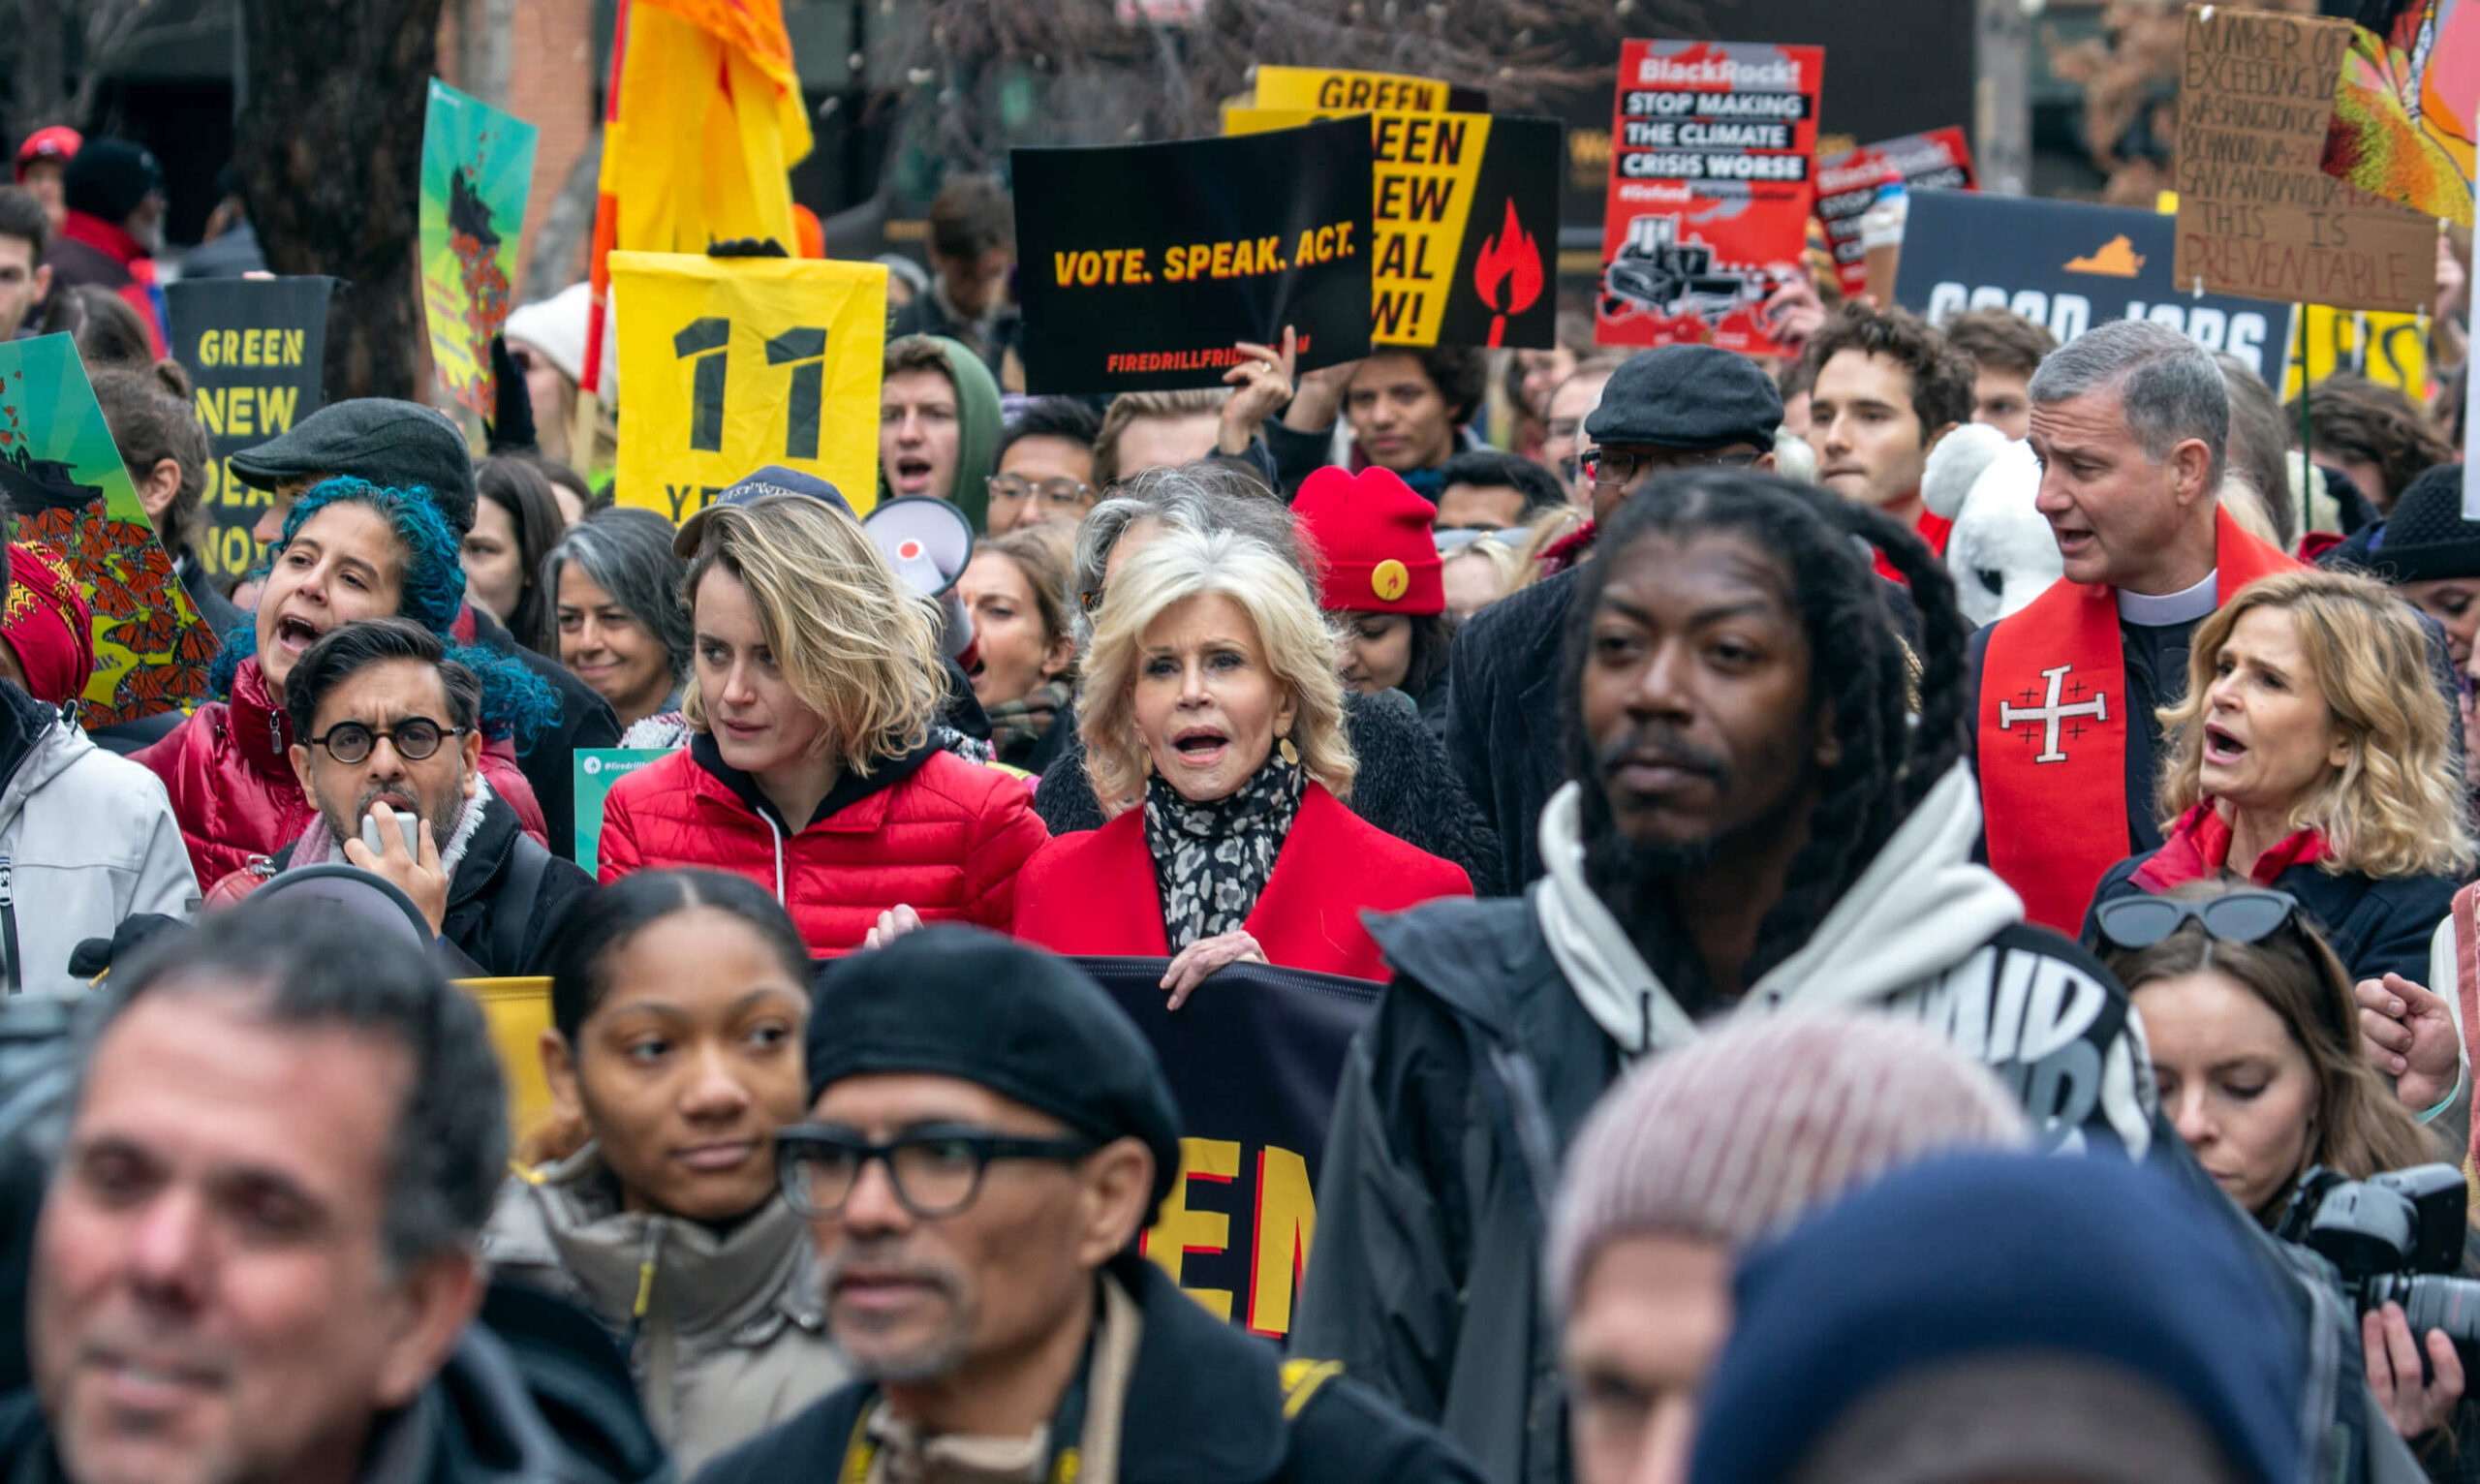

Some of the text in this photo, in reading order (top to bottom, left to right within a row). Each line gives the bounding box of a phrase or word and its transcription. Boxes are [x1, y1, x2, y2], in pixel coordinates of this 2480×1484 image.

[2186, 10, 2303, 64] NUMBER
[1637, 57, 1801, 86] BlackRock!
[1627, 92, 1804, 119] STOP MAKING
[1373, 116, 1467, 166] EEN
[1626, 122, 1676, 145] THE
[1678, 123, 1787, 147] CLIMATE
[1622, 152, 1705, 177] CRISIS
[1706, 155, 1805, 181] WORSE
[1374, 173, 1456, 223] EW
[2196, 201, 2348, 249] THIS IS
[1055, 221, 1355, 288] VOTE. SPEAK. ACT.
[1374, 232, 1435, 281] AL
[2183, 232, 2411, 304] PREVENTABLE
[1926, 281, 2091, 343] GD
[199, 328, 304, 367] GREEN
[195, 386, 299, 437] NEW
[673, 316, 827, 461] 11
[196, 525, 267, 576] NO
